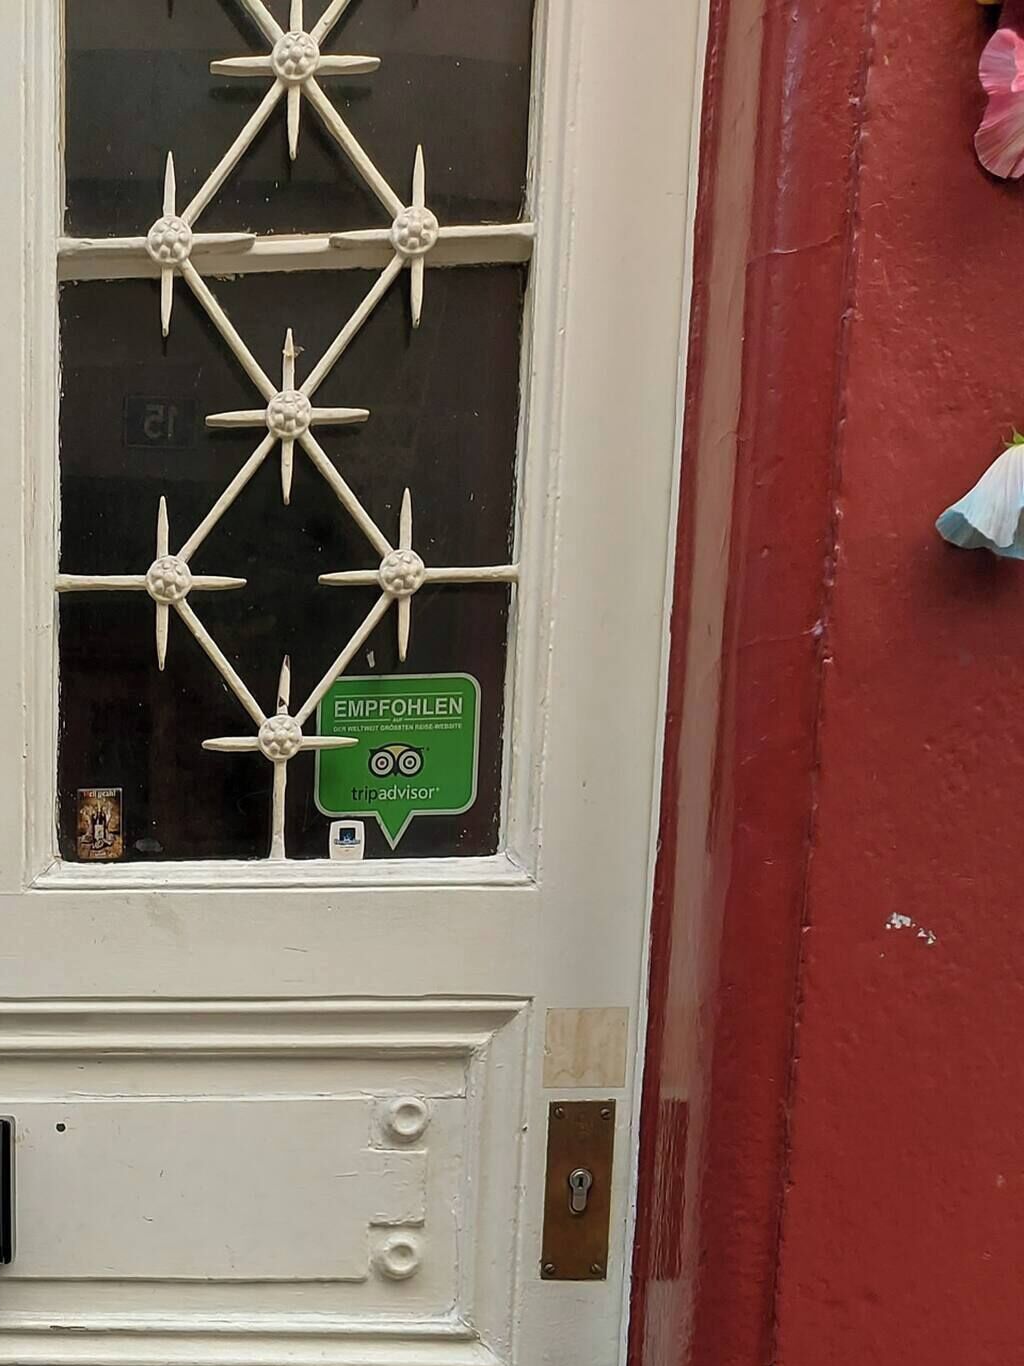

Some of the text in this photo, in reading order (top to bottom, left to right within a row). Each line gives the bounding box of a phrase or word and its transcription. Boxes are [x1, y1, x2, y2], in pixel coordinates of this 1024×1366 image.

[334, 697, 463, 718] EMPFOHLEN
[333, 725, 347, 733] DER
[348, 724, 379, 732] WELTWEIT
[380, 722, 414, 731] GRÖSSTEN
[352, 785, 436, 804] tripadvisor
